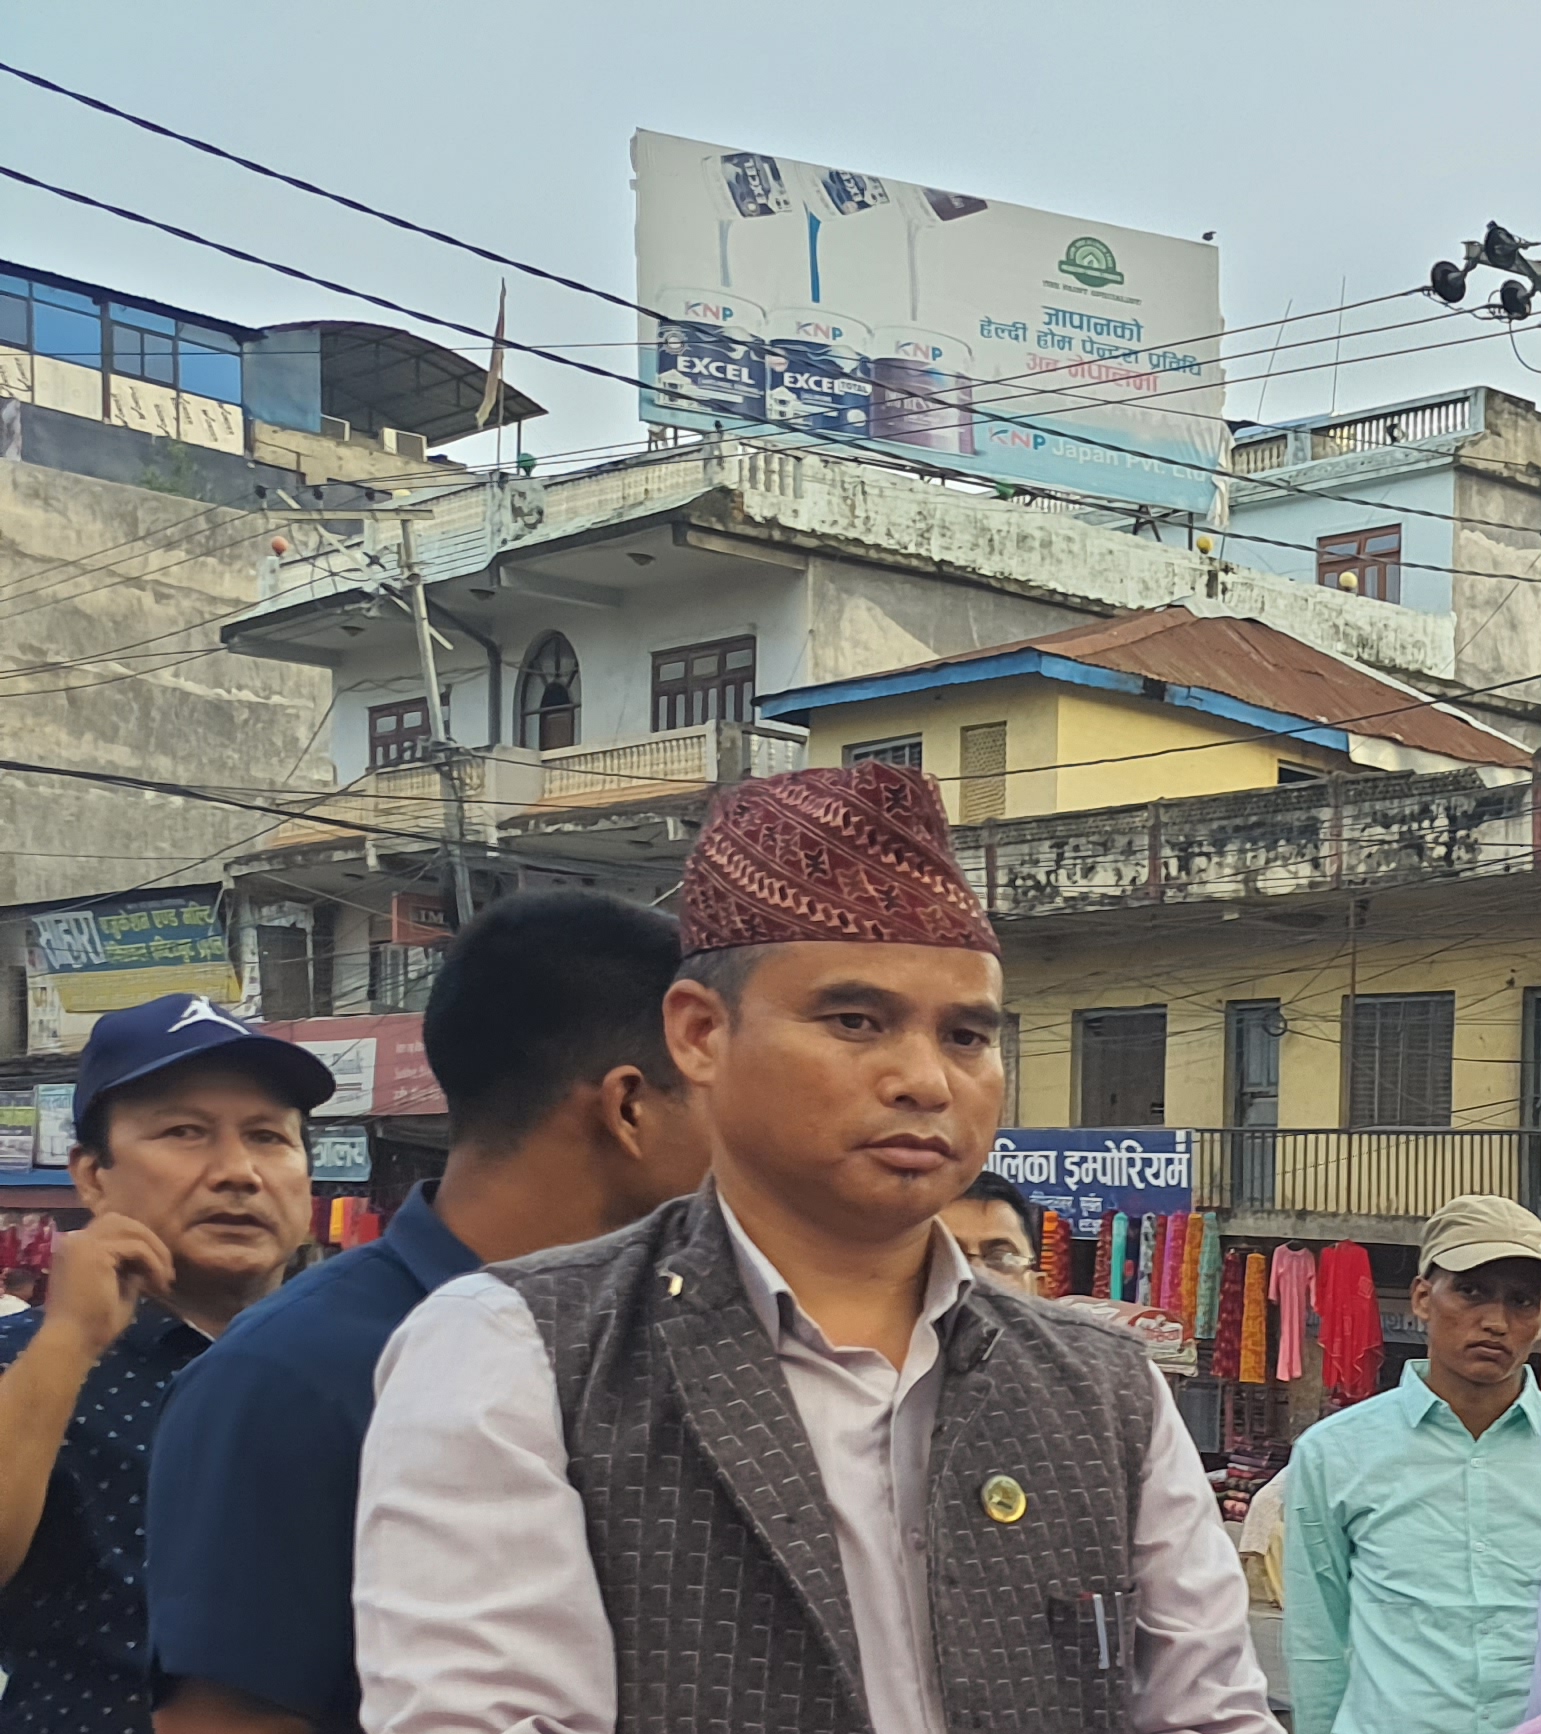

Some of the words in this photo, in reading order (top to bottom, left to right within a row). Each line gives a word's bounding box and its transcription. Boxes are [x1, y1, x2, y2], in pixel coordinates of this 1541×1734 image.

[684, 302, 734, 322] KNP
[795, 322, 843, 341] KNP
[1041, 305, 1144, 343] जापानको
[1036, 328, 1073, 351] होम
[895, 341, 943, 362] KNP
[676, 355, 756, 385] EXCEL
[783, 372, 841, 396] EXCEL
[988, 426, 1046, 450] KNP
[1052, 440, 1119, 466] Japan
